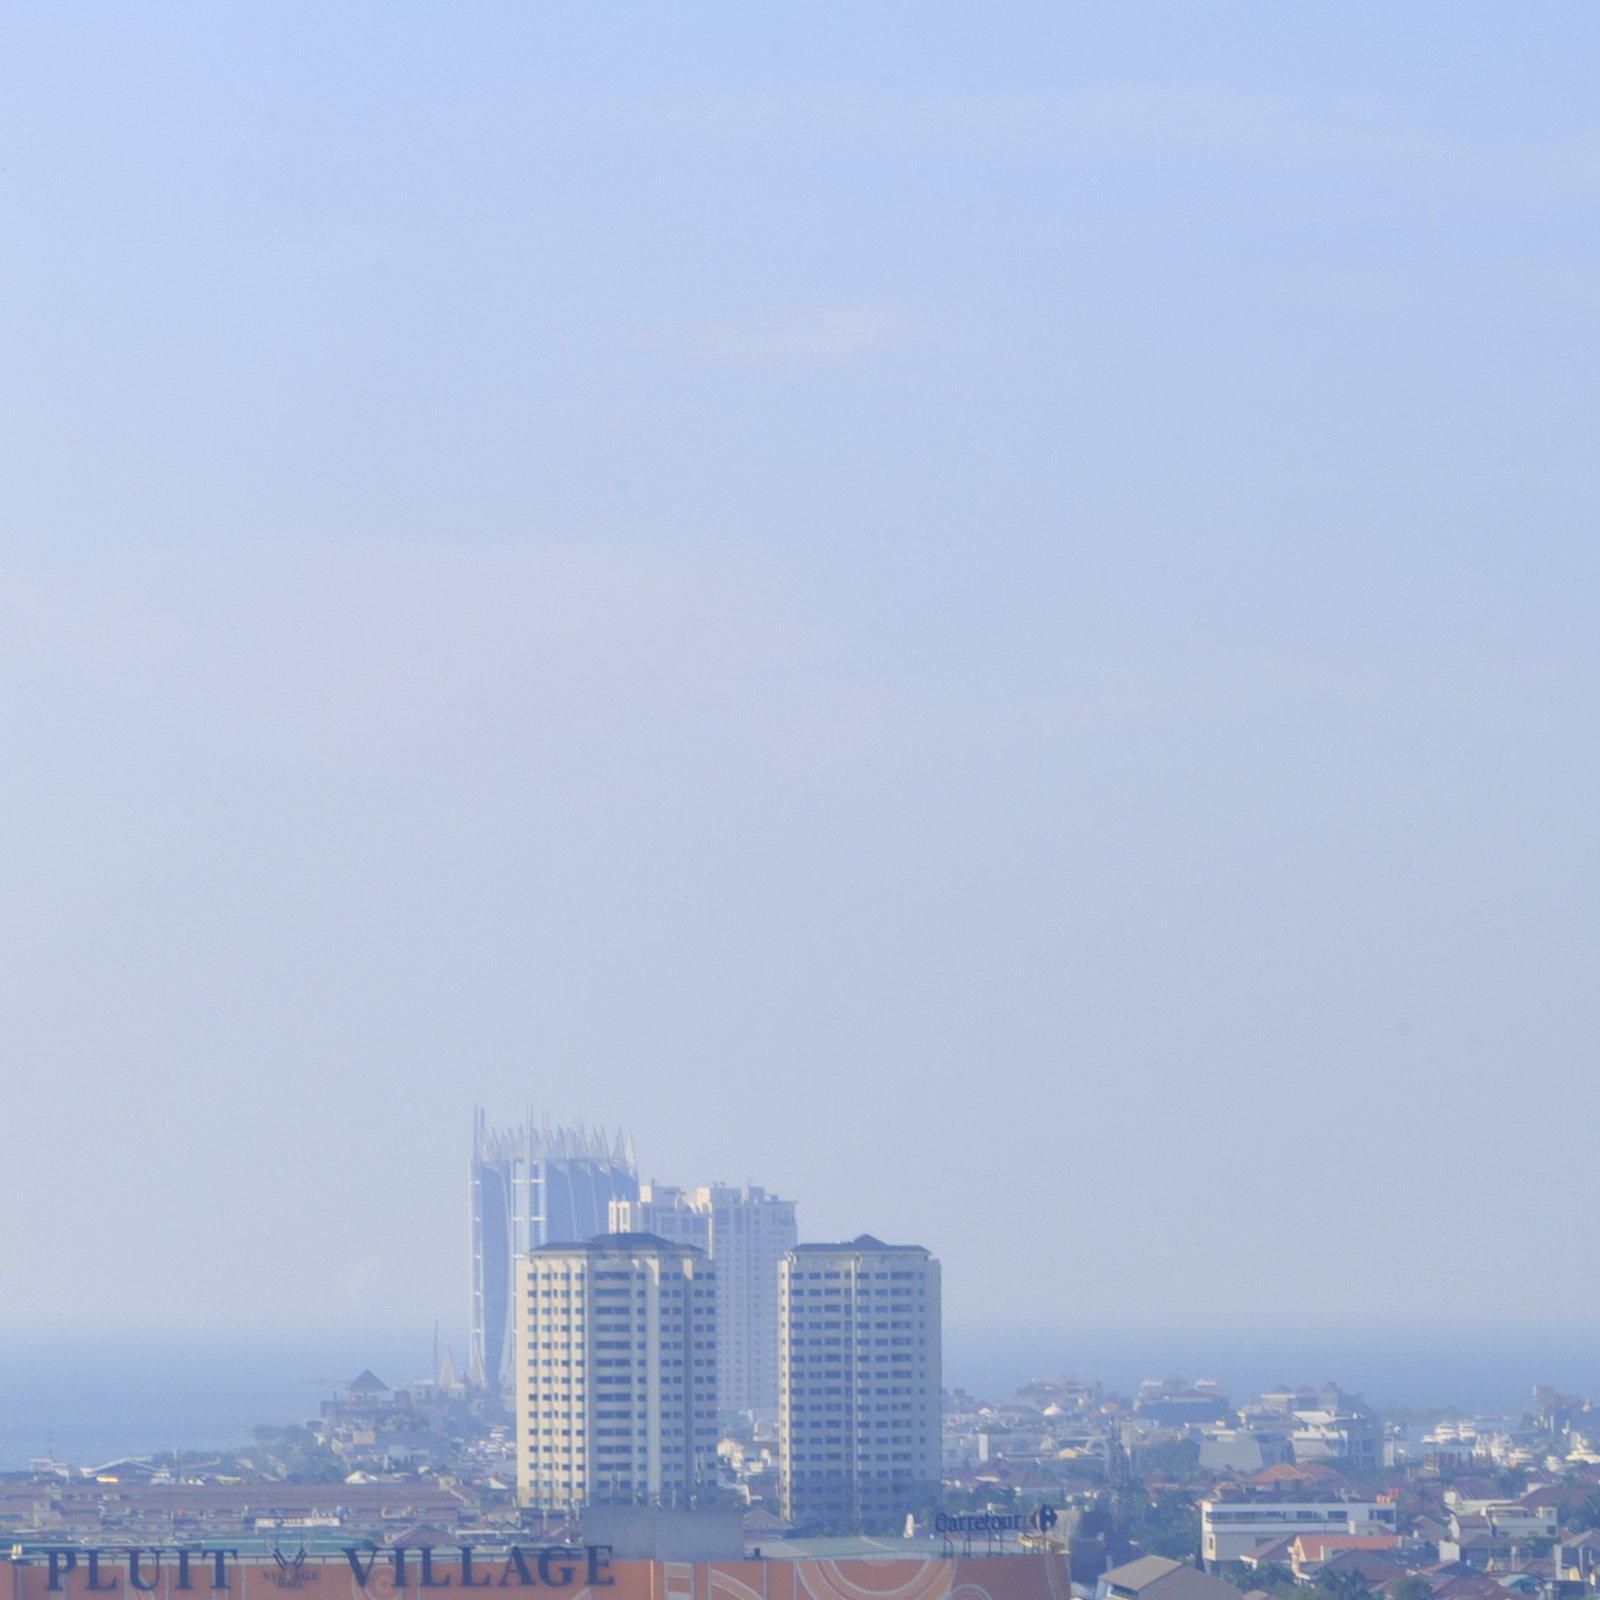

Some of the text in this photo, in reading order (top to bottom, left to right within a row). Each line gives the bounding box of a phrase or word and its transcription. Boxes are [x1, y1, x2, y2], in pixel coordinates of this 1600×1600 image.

[935, 1511, 1021, 1532] Carrefour
[44, 1545, 615, 1590] PLUIT VILLAGE
